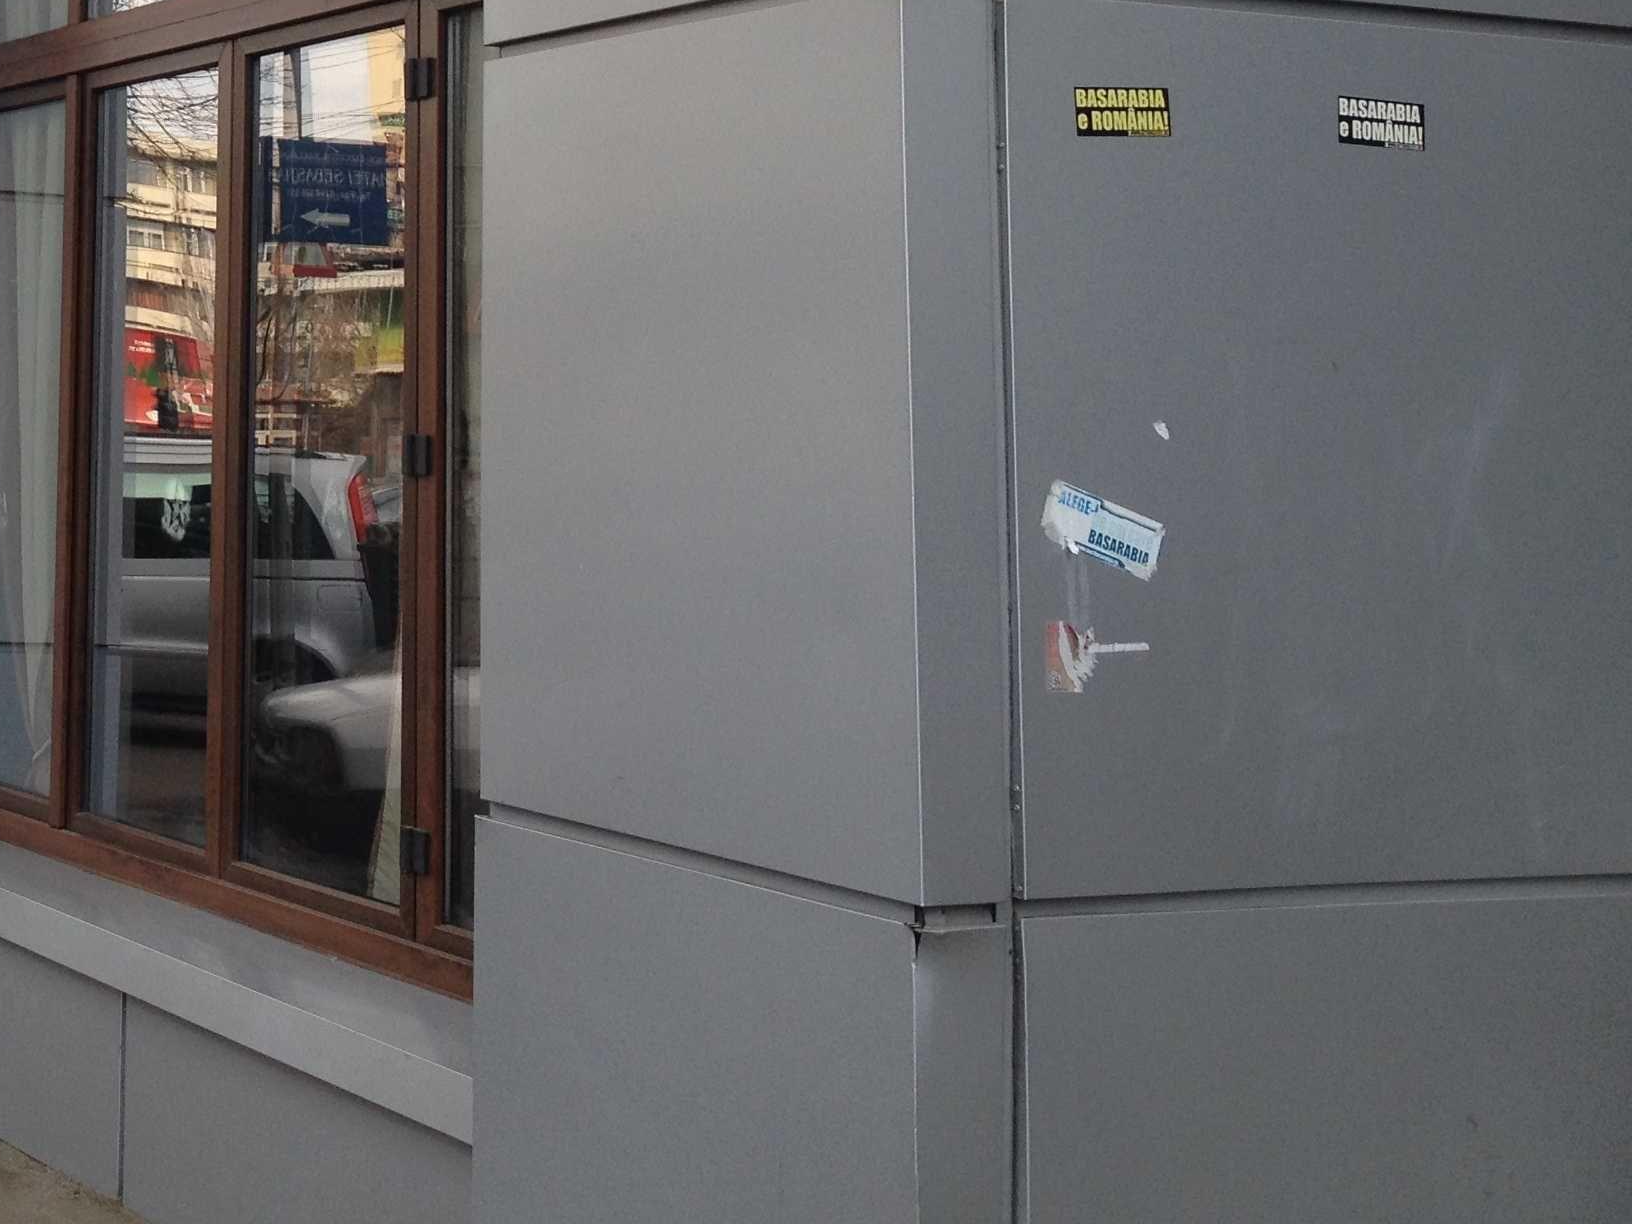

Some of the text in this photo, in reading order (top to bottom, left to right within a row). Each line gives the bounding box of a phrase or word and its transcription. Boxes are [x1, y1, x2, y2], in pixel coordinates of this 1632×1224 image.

[1075, 88, 1165, 108] BASARABIA
[1339, 97, 1421, 124] BASARABIA
[1077, 108, 1168, 131] e ROMÂNIA!
[1339, 120, 1423, 145] e ROMÂNIA!
[1088, 529, 1150, 565] BASARABIA
